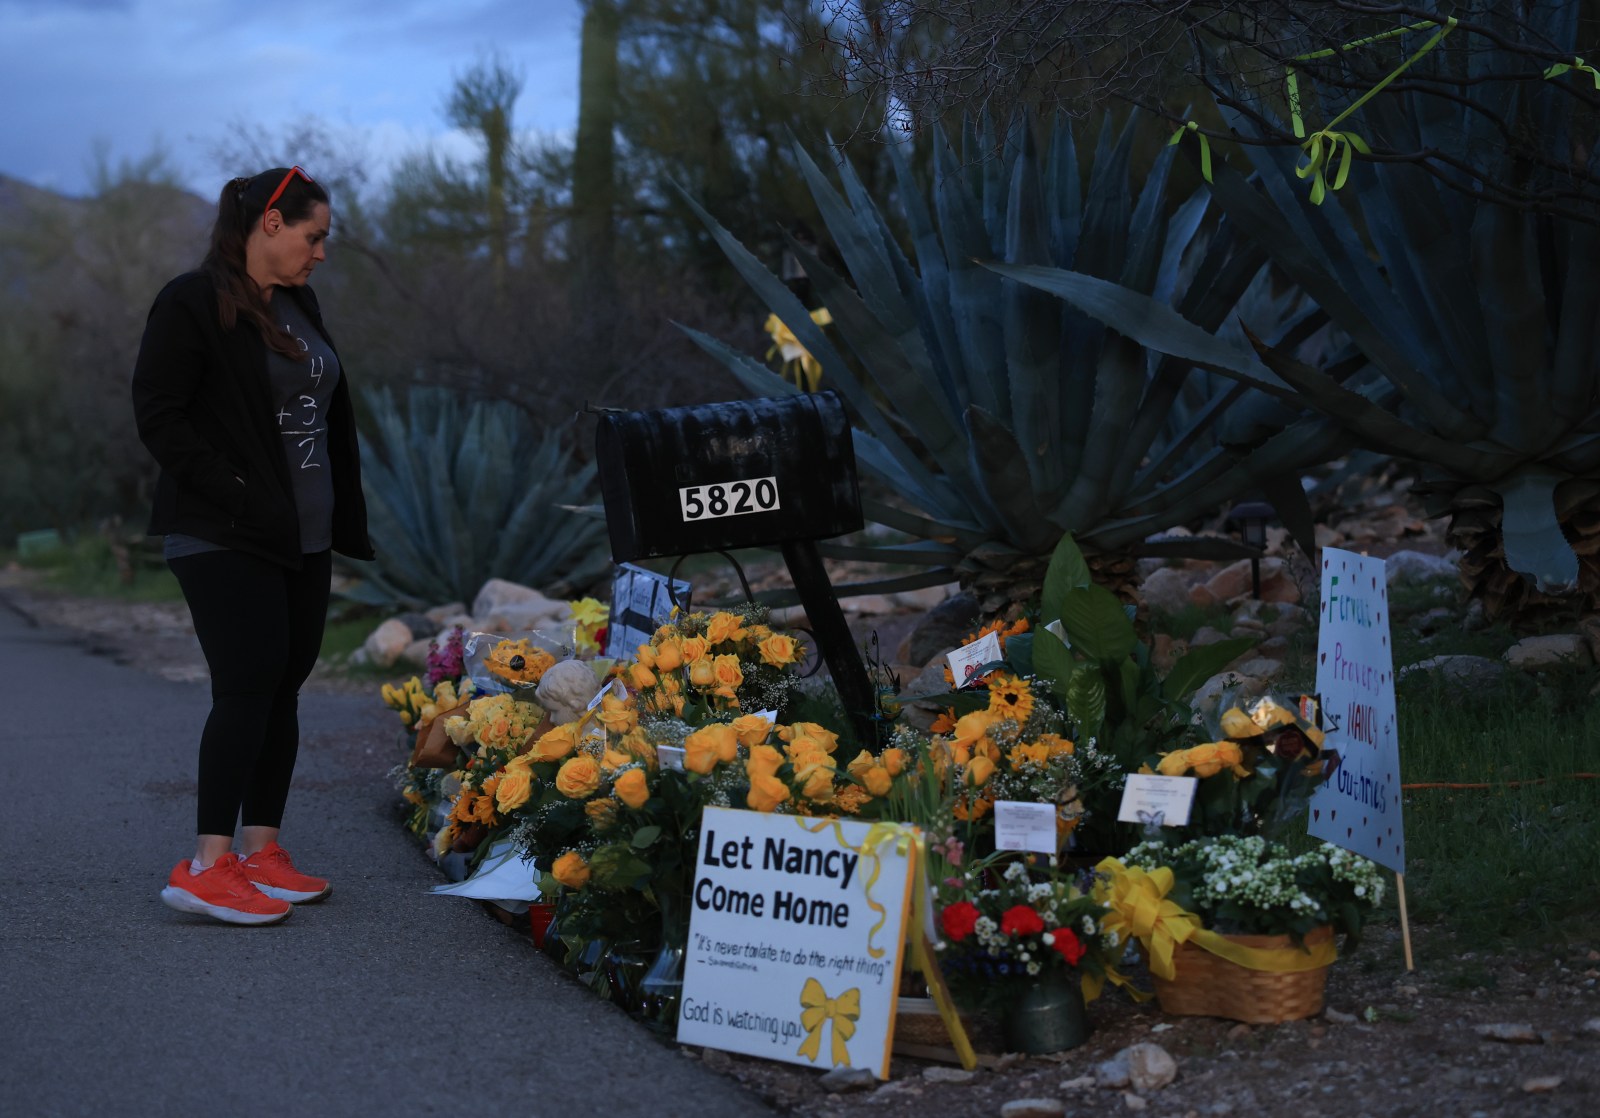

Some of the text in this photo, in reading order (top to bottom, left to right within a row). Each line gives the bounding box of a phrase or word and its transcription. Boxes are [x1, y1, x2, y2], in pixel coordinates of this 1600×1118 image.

[311, 356, 324, 389] 4
[298, 437, 320, 469] 2
[686, 479, 776, 519] 5820
[1329, 576, 1372, 628] Fervent
[1347, 701, 1378, 750] NANCY
[1338, 755, 1386, 814] Guthries
[703, 830, 859, 889] Let Nancy
[695, 878, 849, 928] Come Home
[713, 941, 744, 956] never
[759, 942, 778, 962] late
[780, 948, 791, 963] to
[793, 948, 807, 965] do
[808, 950, 826, 968] the
[827, 955, 854, 976] right
[682, 997, 709, 1023] God
[713, 1002, 722, 1025] is
[782, 1019, 801, 1045] you
